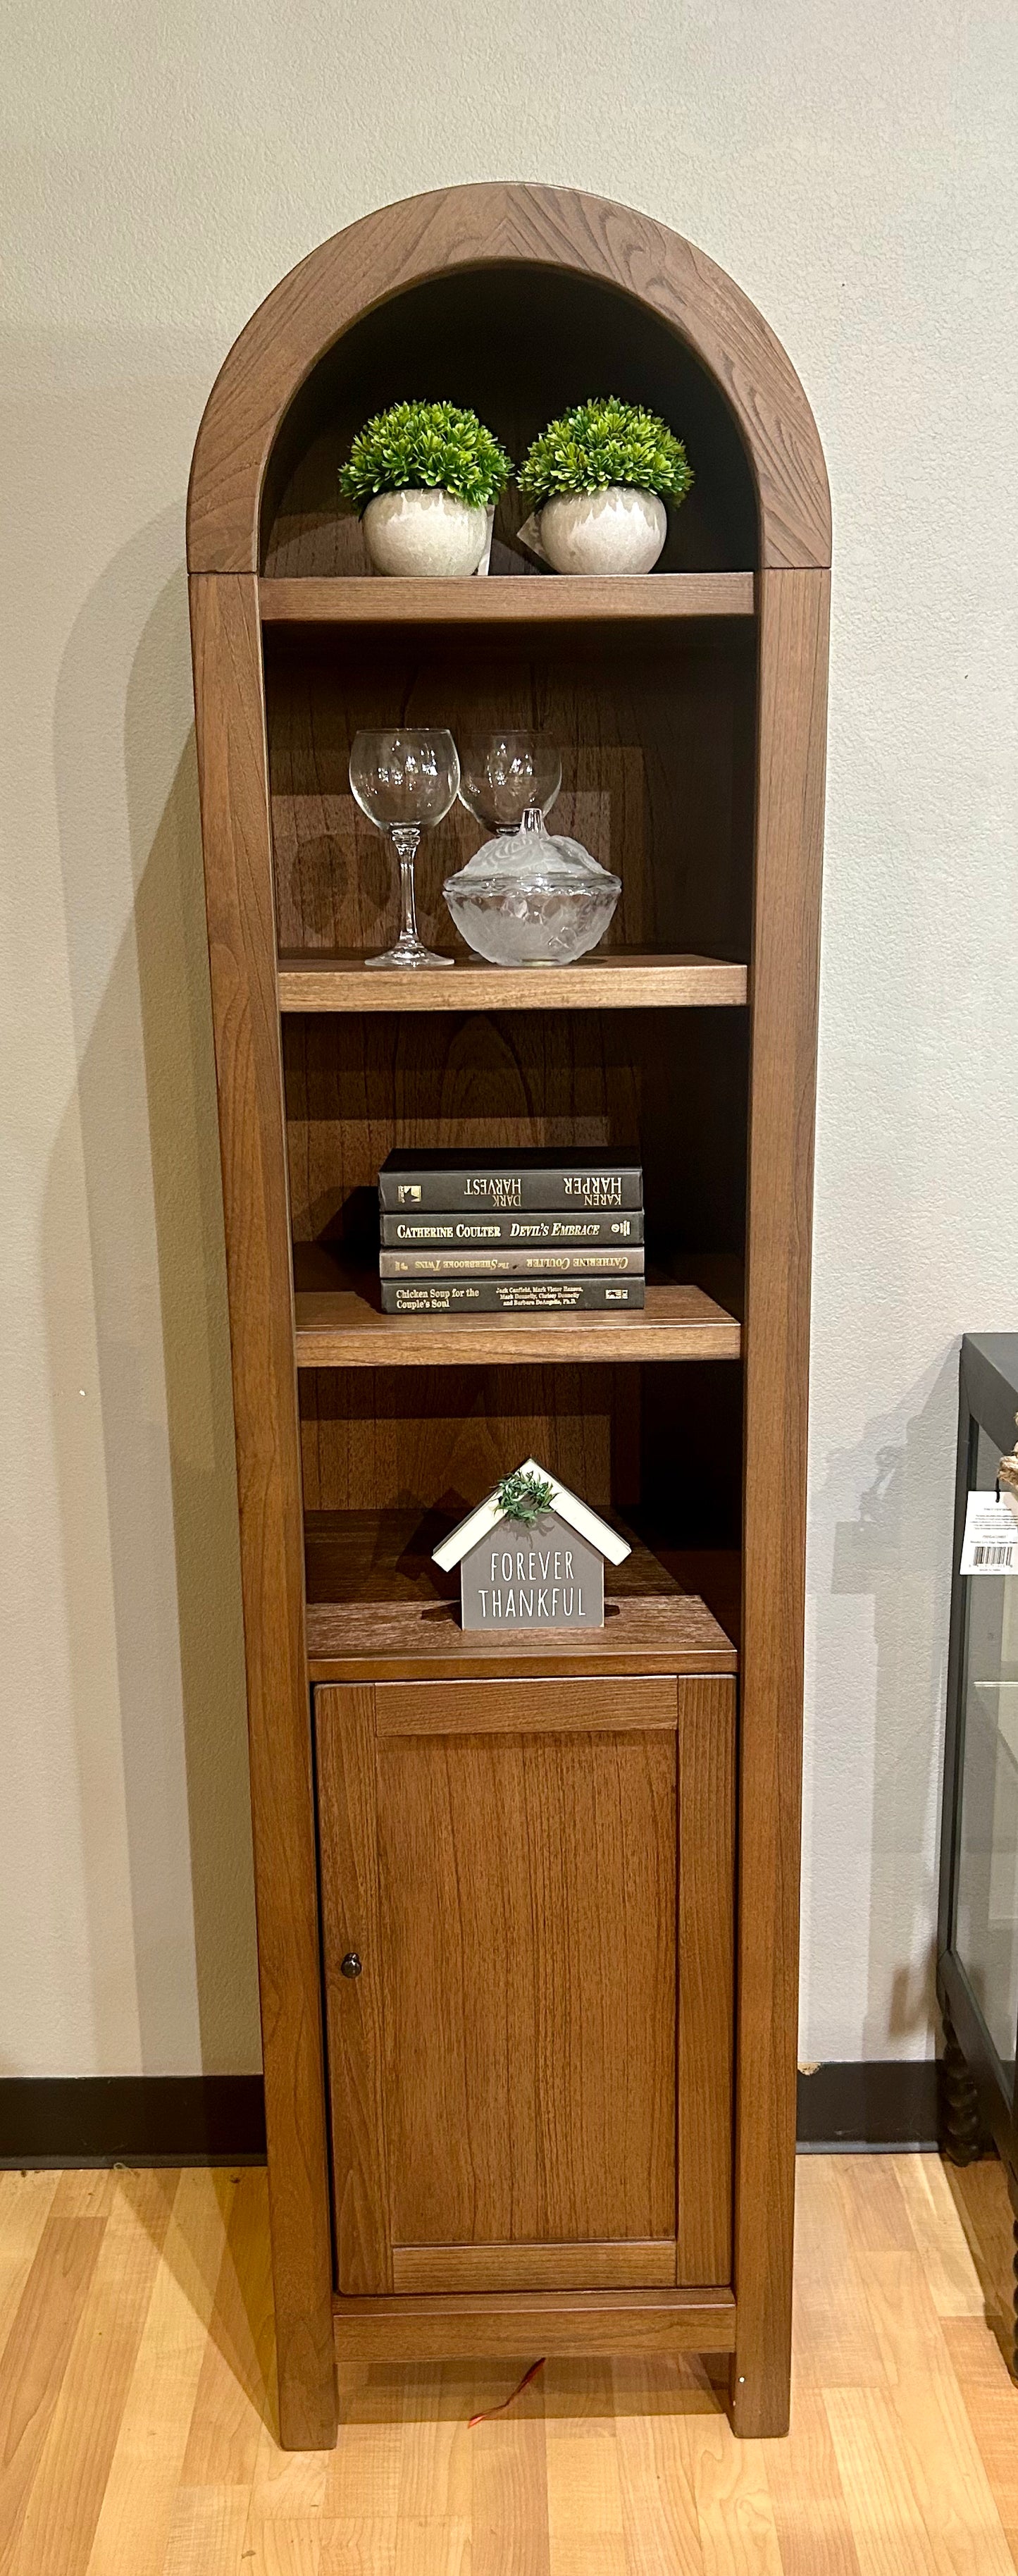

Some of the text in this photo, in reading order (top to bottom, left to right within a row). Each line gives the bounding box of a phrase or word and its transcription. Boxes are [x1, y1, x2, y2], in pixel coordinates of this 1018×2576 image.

[464, 1178, 521, 1195] HARVEST
[564, 1178, 622, 1195] HARPER
[492, 1195, 521, 1207] DARK
[583, 1194, 621, 1206] KAREN
[397, 1222, 600, 1238] CATHERINE COULTER DEVIL'S EMBRACE
[414, 1259, 441, 1271] TWINS
[442, 1259, 498, 1271] SHERBROOKE
[526, 1257, 570, 1270] COULTER
[573, 1257, 628, 1269] CATHERINE
[396, 1288, 480, 1300] Chicken Soup for the
[397, 1299, 450, 1310] Couple's Soul
[490, 1551, 574, 1582] FOREVER
[478, 1587, 586, 1617] THANKFUL
